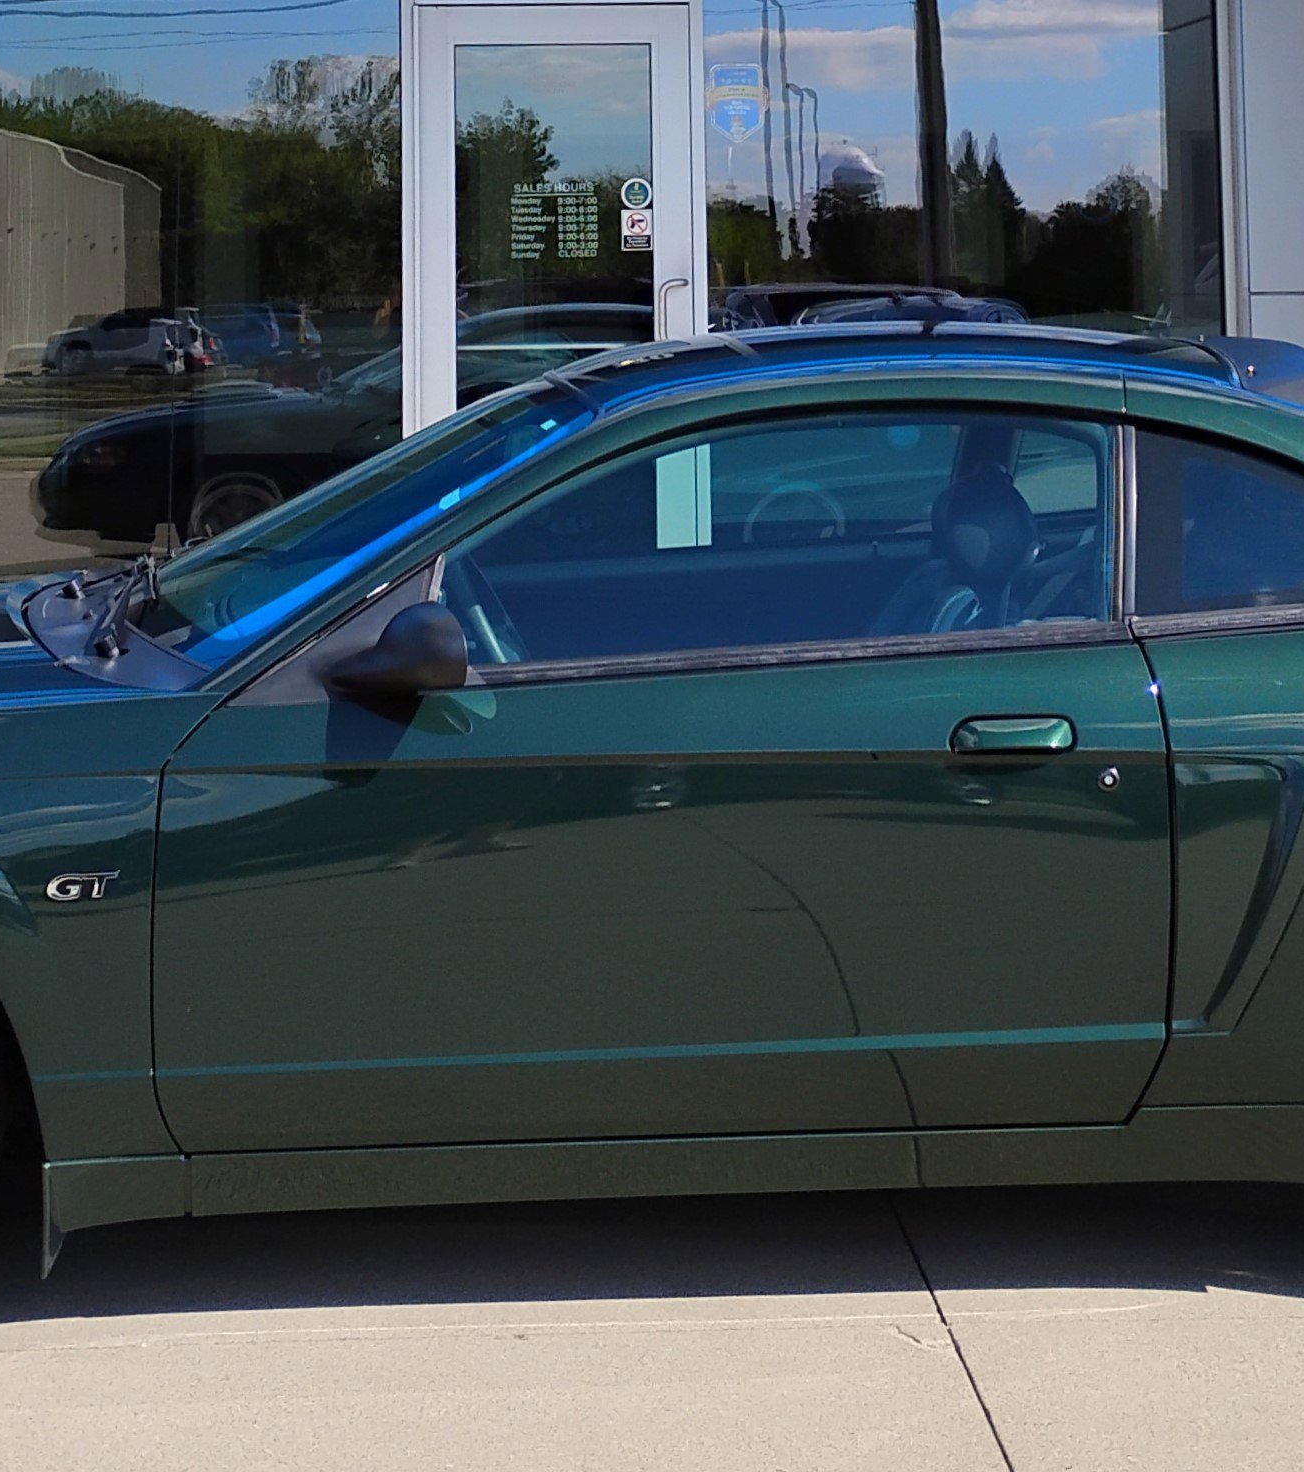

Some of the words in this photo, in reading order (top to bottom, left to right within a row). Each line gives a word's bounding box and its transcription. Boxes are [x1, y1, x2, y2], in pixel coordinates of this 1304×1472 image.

[513, 183, 551, 193] SALES
[554, 182, 594, 192] HOURS
[511, 197, 542, 206] Monday
[511, 206, 542, 215] Tuesday
[511, 215, 556, 224] Wednesday
[511, 224, 547, 233] Thursday
[511, 233, 536, 242] Friday
[511, 242, 546, 251] Saturday
[511, 251, 541, 260] Sunday
[558, 250, 597, 258] CLOSED
[46, 869, 121, 901] GT
